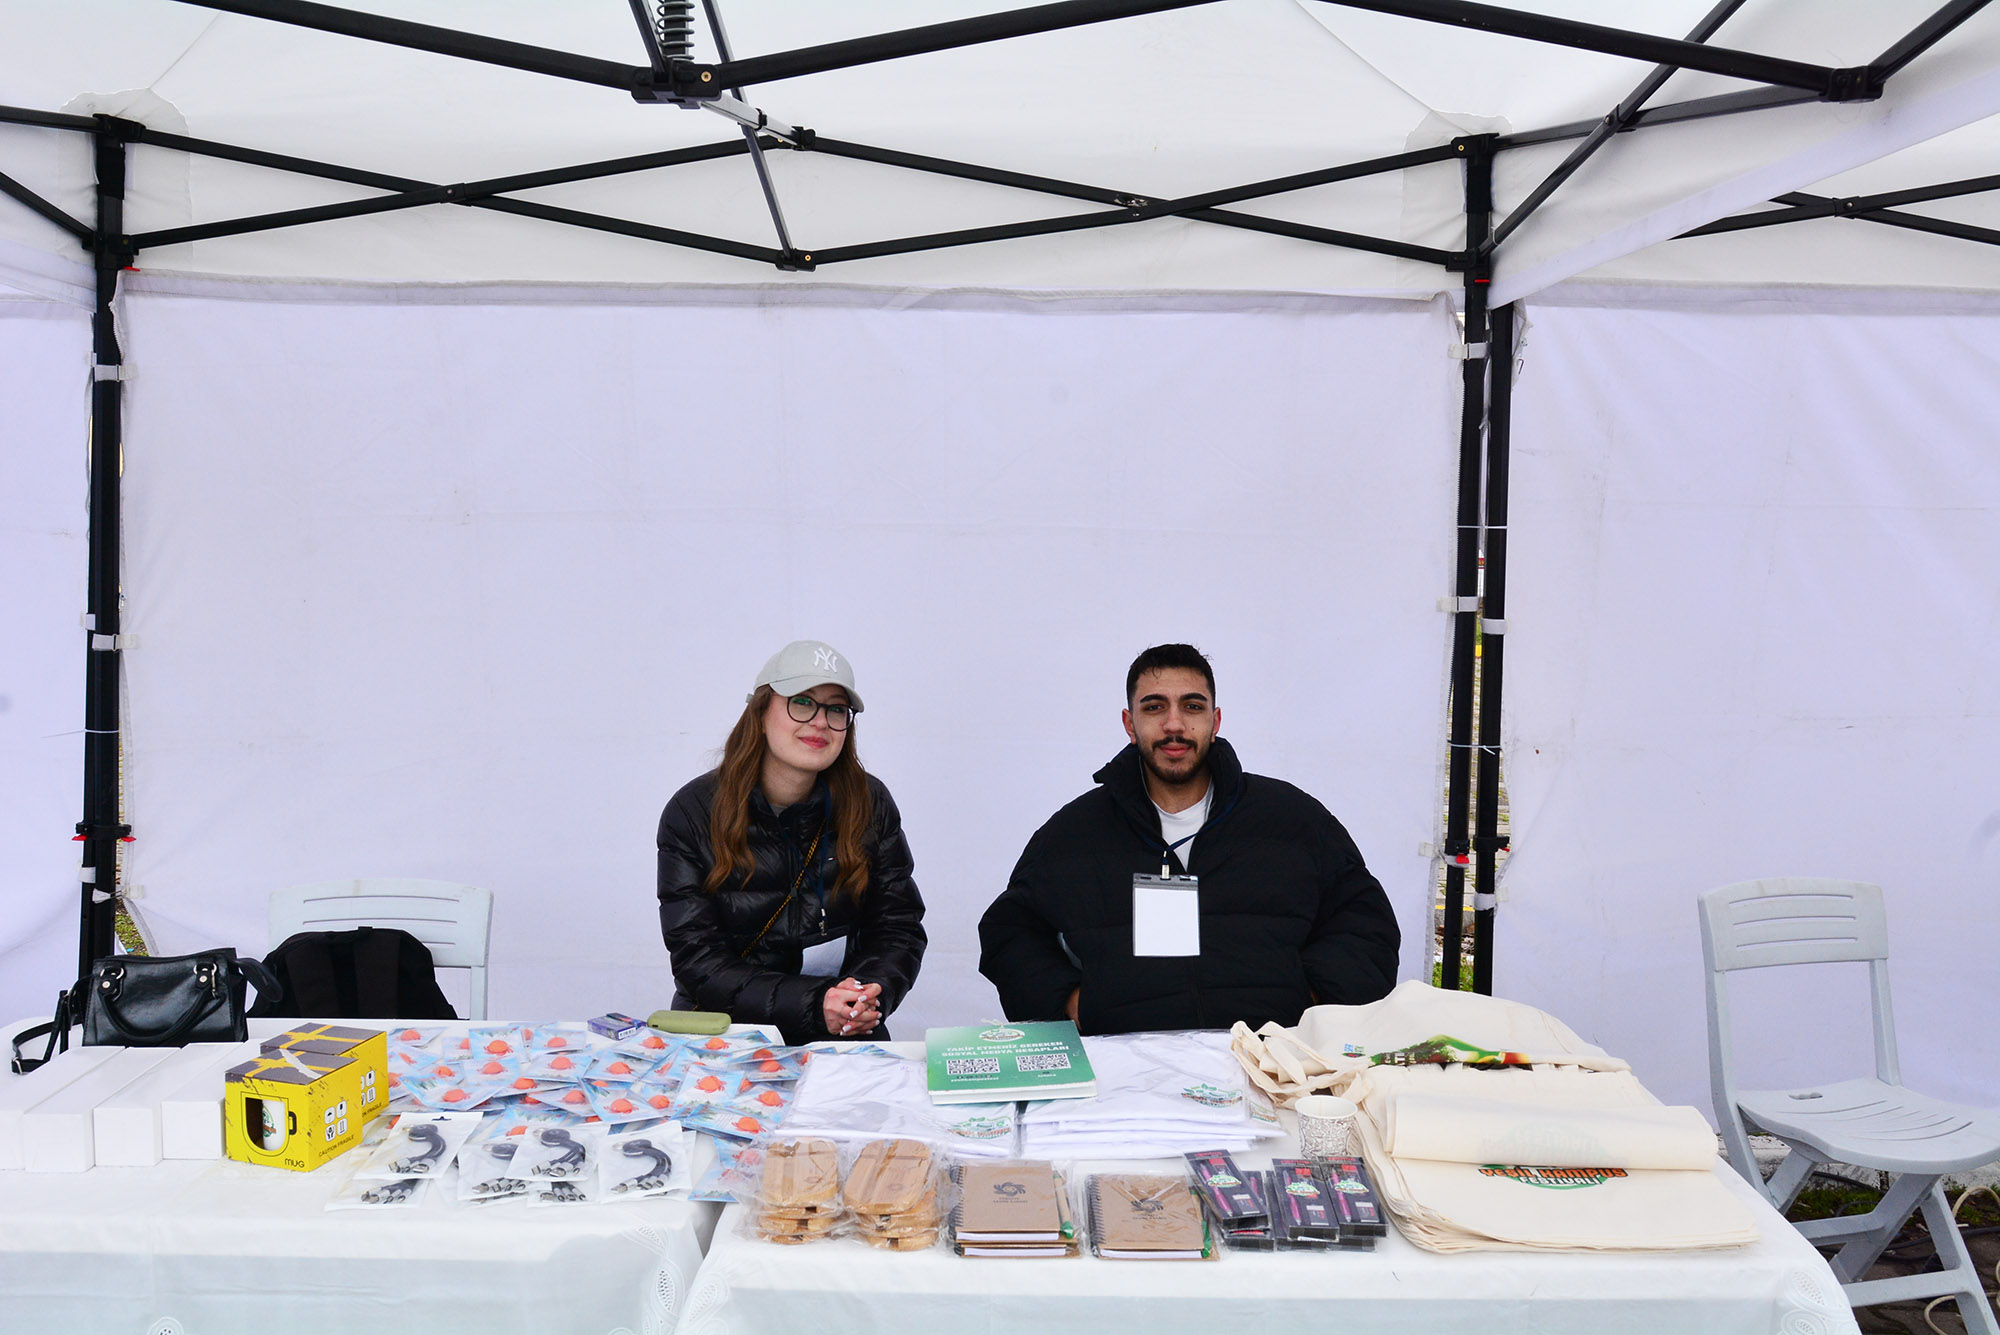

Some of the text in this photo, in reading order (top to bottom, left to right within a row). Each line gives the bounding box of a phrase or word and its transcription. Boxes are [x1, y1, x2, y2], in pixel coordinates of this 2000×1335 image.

[813, 647, 838, 673] NY
[1016, 1045, 1070, 1053] HESAPLARI
[318, 1135, 354, 1157] CAUTION FRAGILE
[284, 1158, 305, 1168] MUG
